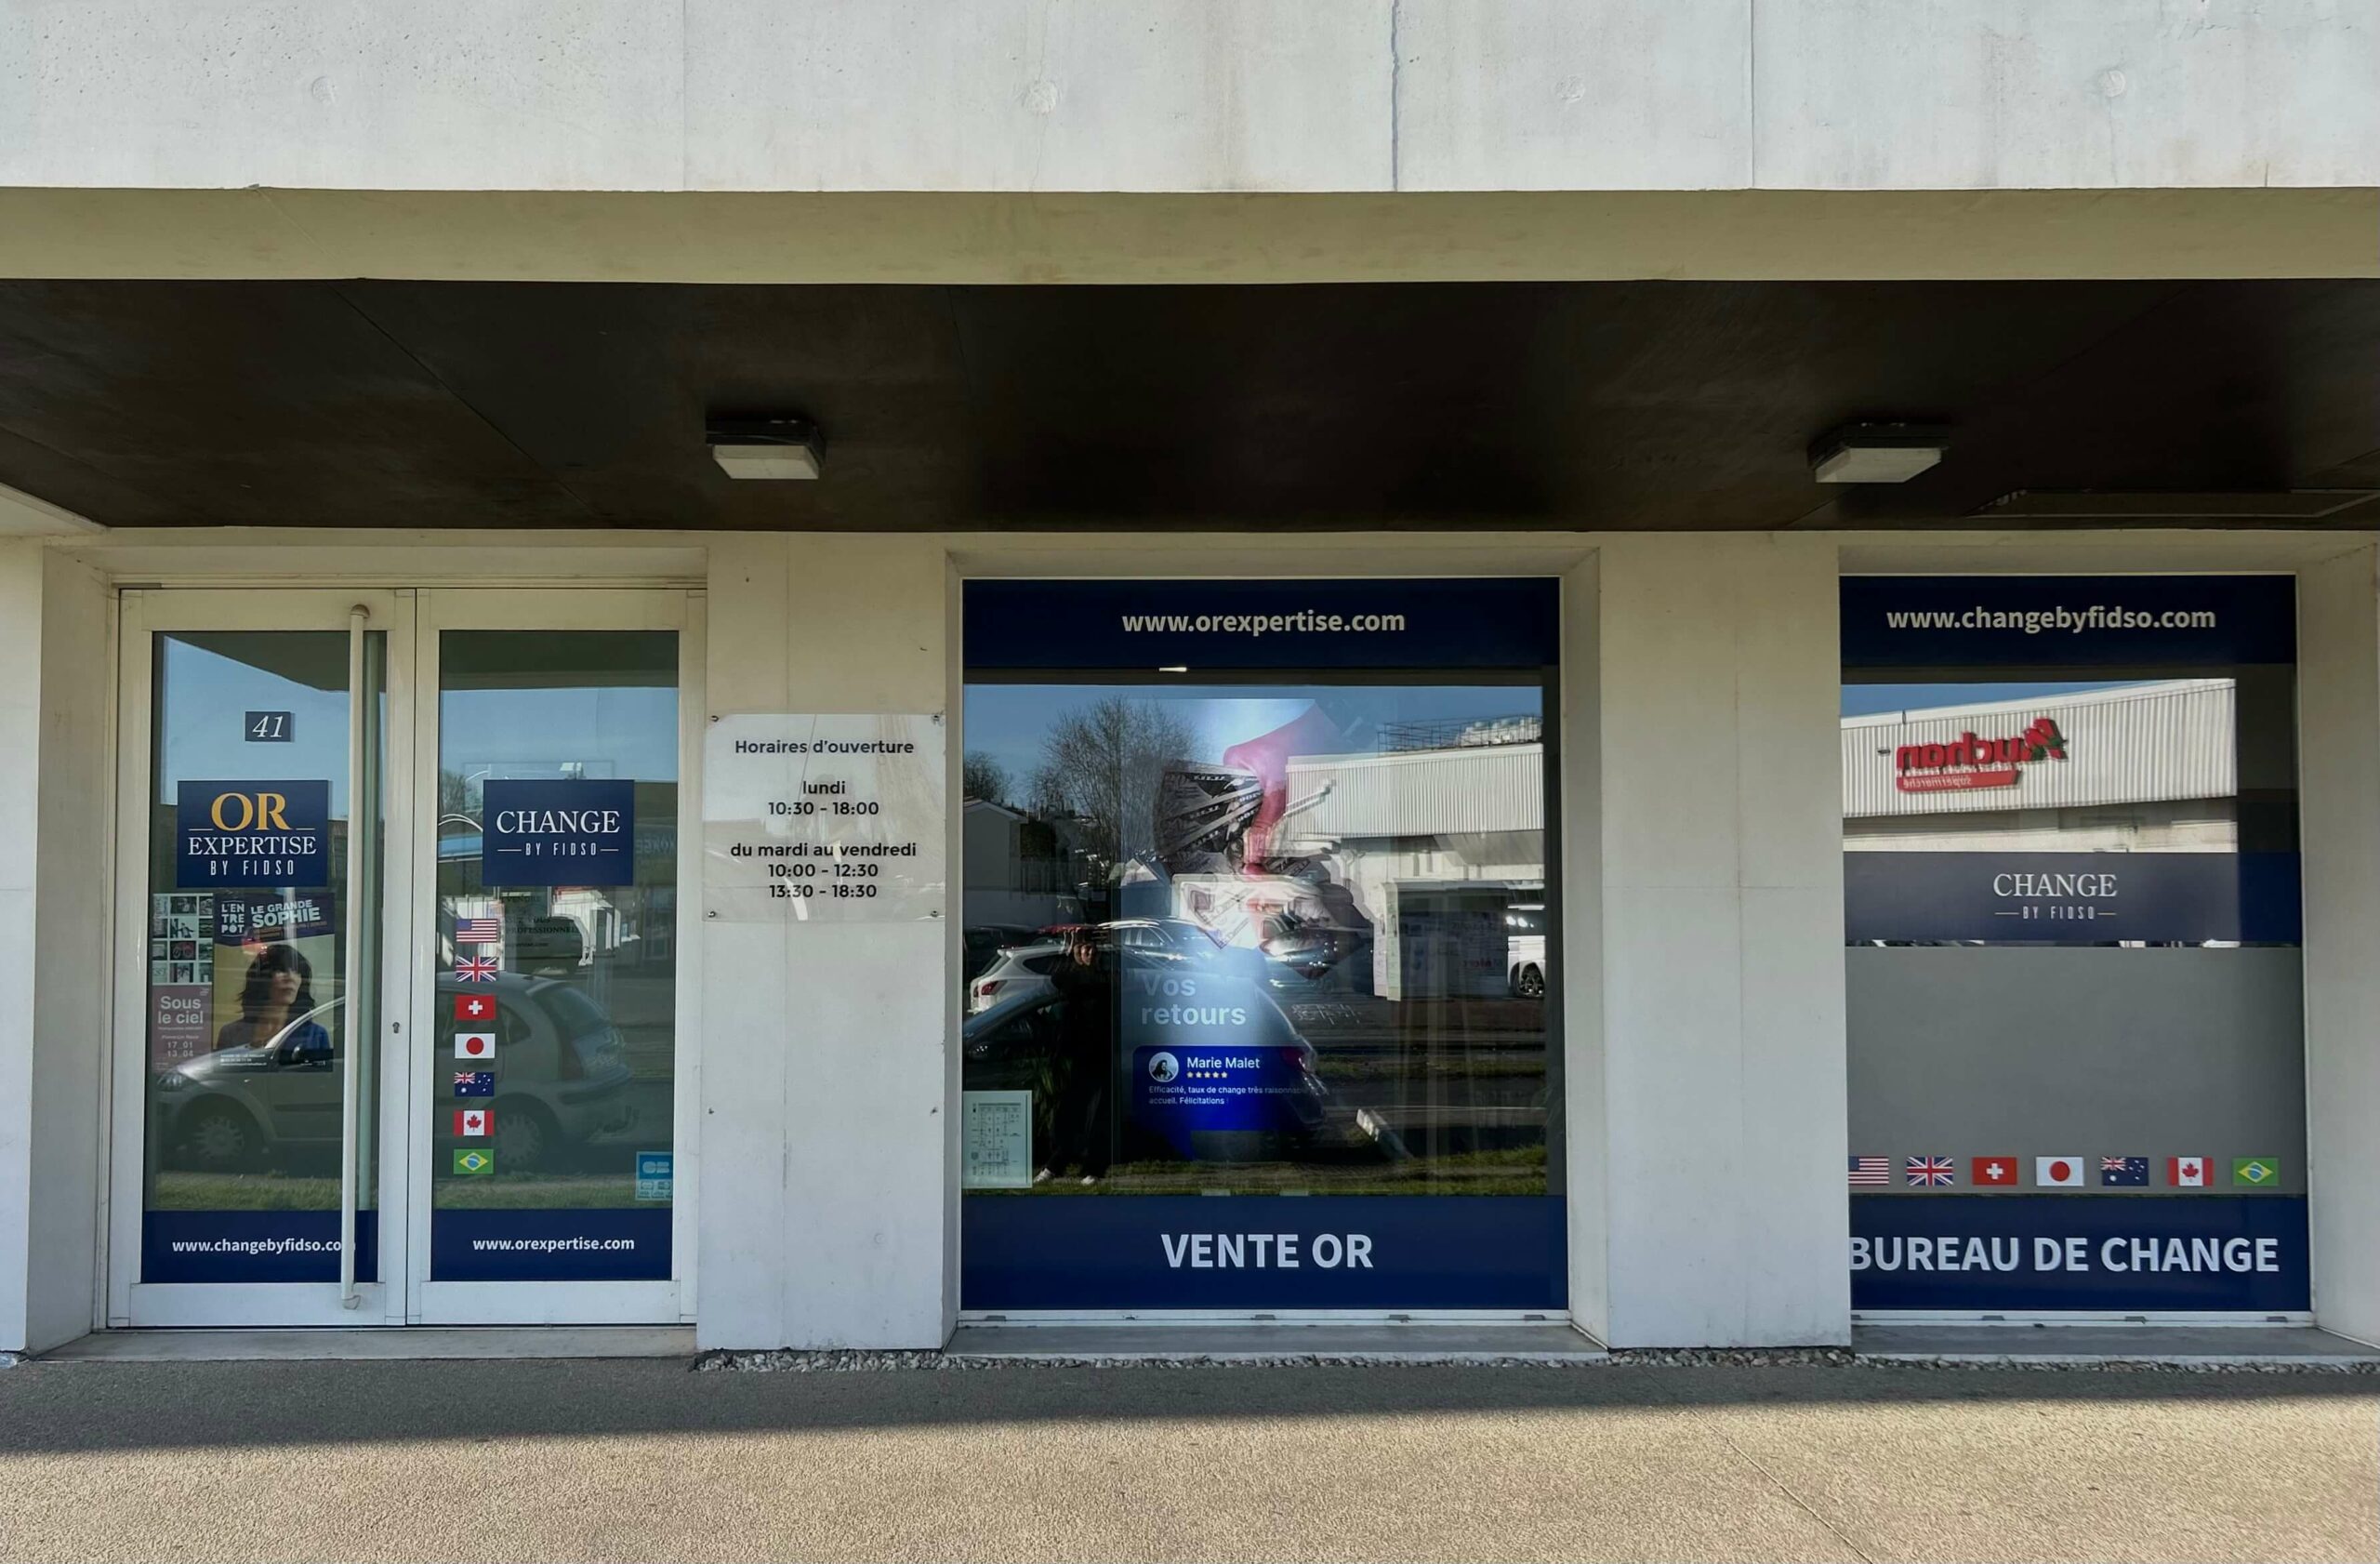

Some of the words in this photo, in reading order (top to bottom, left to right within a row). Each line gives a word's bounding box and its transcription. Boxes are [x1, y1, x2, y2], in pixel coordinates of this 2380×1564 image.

[1121, 609, 1405, 637] www.orexpertise.com
[1886, 605, 2216, 634] www.changebyfidso.com
[252, 715, 284, 738] 41
[735, 739, 808, 754] Horaires
[813, 739, 915, 754] d'ouverture
[802, 780, 846, 795] lundi
[211, 792, 291, 831] OR
[768, 802, 814, 815] 10:30
[832, 802, 879, 815] 18:00
[496, 810, 620, 834] CHANGE
[188, 836, 317, 855] EXPERTISE
[525, 842, 541, 856] BY
[553, 842, 597, 856] FIDSO
[730, 842, 753, 856] du
[758, 842, 808, 856] mardi
[813, 845, 834, 856] au
[840, 842, 917, 856] vendredi
[210, 860, 230, 876] BY
[243, 860, 294, 876] FIDSO
[768, 864, 816, 878] 10:00
[833, 864, 879, 878] 12:30
[769, 884, 813, 898] 13:30
[831, 884, 878, 898] 18:30
[1993, 873, 2118, 897] CHANGE
[221, 903, 245, 913] L'EN
[250, 907, 264, 915] LE
[267, 899, 313, 911] GRANDE
[2022, 906, 2039, 920] BY
[2050, 906, 2095, 920] FIDSO
[221, 913, 245, 923] TRE
[252, 908, 322, 928] SOPHIE
[1143, 977, 1196, 997] Vos
[160, 995, 202, 1010] Sous
[157, 1011, 172, 1024] le
[176, 1010, 204, 1024] ciel
[1142, 1003, 1247, 1026] retours
[1186, 1056, 1223, 1069] Marie
[1225, 1056, 1261, 1069] Malet
[1218, 1086, 1247, 1095] change
[1179, 1096, 1225, 1105] Félicitations
[172, 1238, 355, 1255] www.changebyfidso.co
[472, 1236, 635, 1253] www.orexpertise.com
[1160, 1233, 1300, 1268] VENTE
[1312, 1233, 1374, 1268] OR
[1849, 1237, 2019, 1272] BUREAU
[2033, 1237, 2089, 1272] DE
[2100, 1237, 2280, 1273] CHANGE
